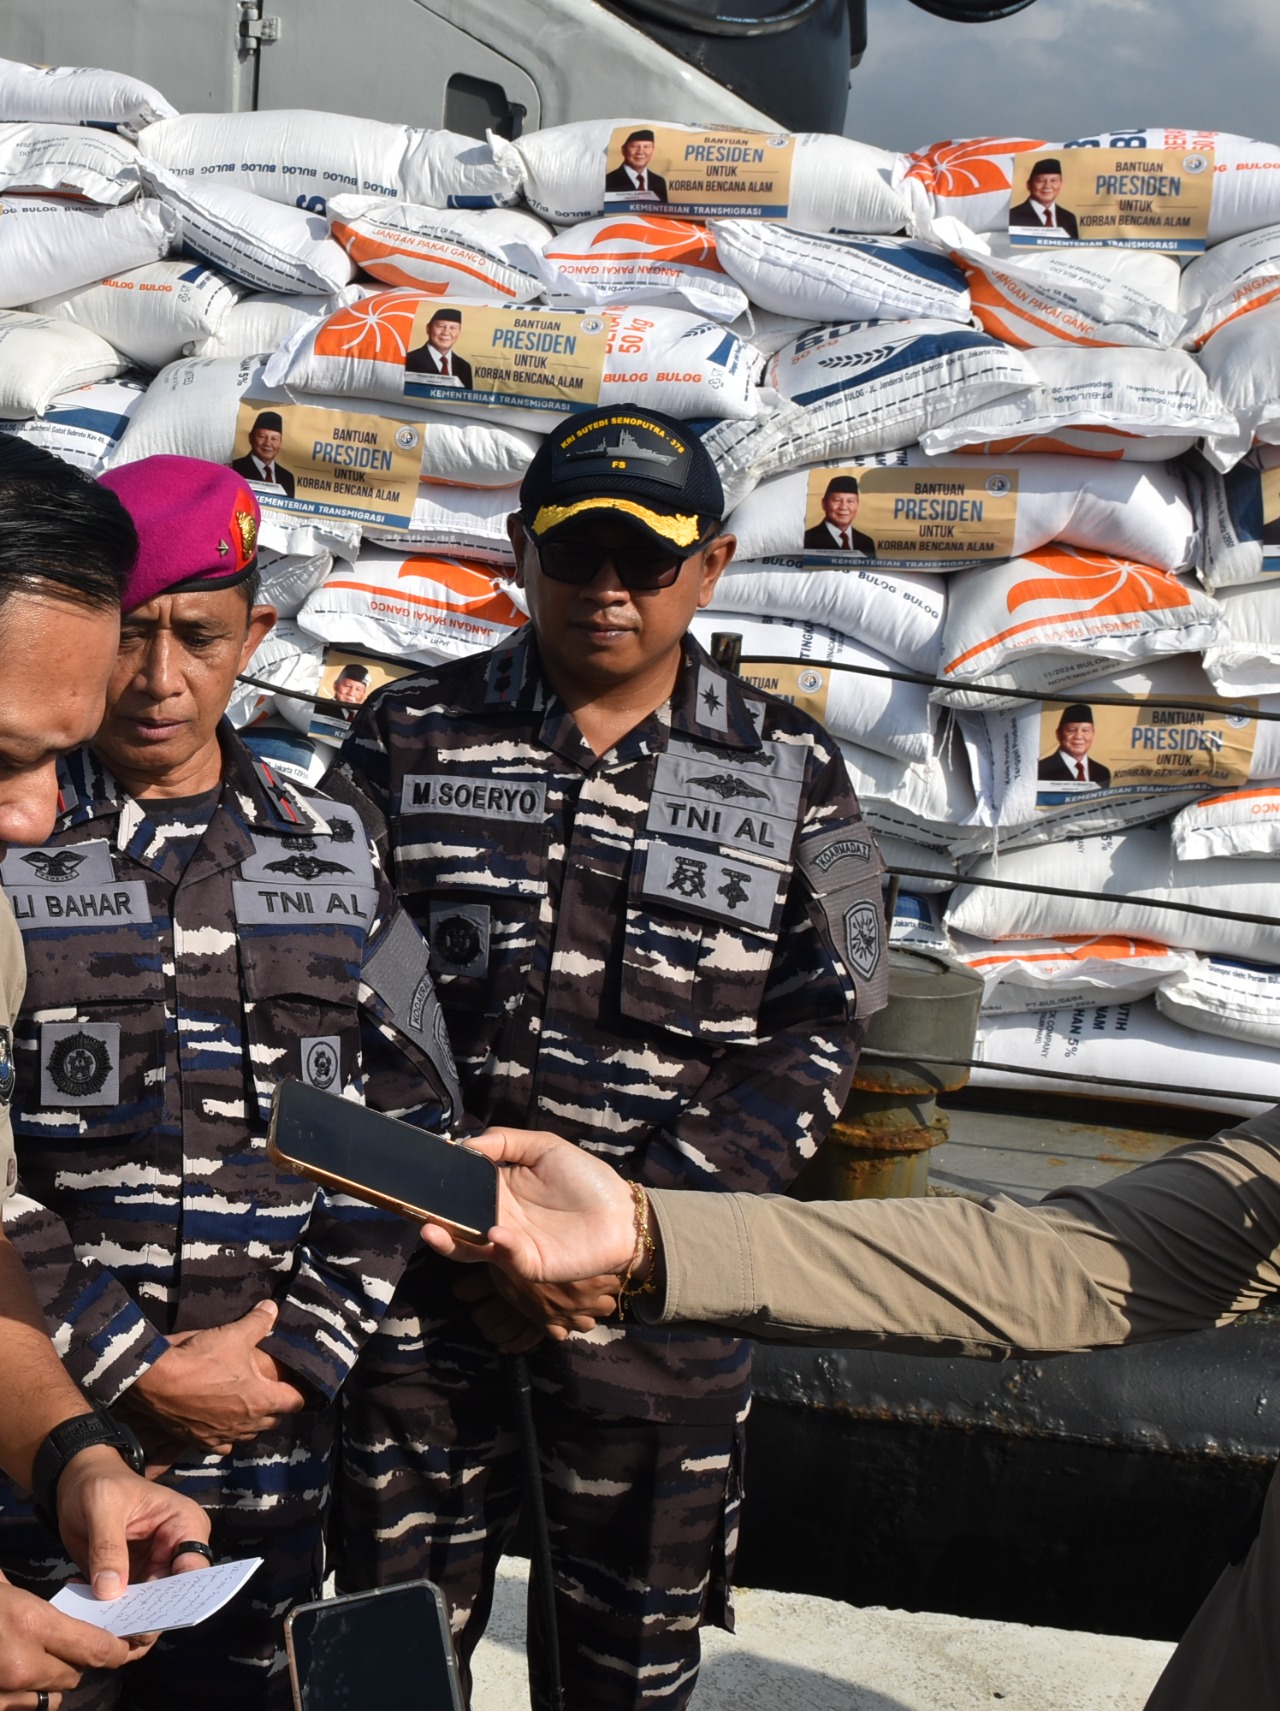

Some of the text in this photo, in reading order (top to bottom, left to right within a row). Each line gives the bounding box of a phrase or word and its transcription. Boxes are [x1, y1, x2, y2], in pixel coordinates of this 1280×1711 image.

[704, 136, 748, 146] BANTUAN
[684, 144, 764, 163] PRESIDEN
[706, 166, 737, 177] UNTUK
[1115, 162, 1163, 173] BANTUAN
[364, 183, 398, 197] BULOG
[668, 180, 773, 193] KORBAN BENCANA ALAM
[1096, 175, 1181, 196] PRESIDEN
[629, 204, 762, 216] KEMENTERIAN TRANSMIGRASI
[1119, 200, 1152, 212] UNTUK
[1079, 214, 1191, 227] KORBAN BENCANA ALAM
[373, 230, 487, 266] JANGAN PAKAI GANCO
[558, 265, 683, 278] JANGAN PAKAI GANCO
[102, 279, 134, 290] BULOG
[991, 270, 1060, 318] JANGAN PAKAI
[514, 318, 561, 332] BANTUAN
[492, 328, 577, 355] PRESIDEN
[514, 353, 547, 369] UNTUK
[475, 366, 584, 389] KORBAN BENCANA ALAM
[603, 371, 702, 383] BULOG BULOG
[879, 376, 904, 391] Jenderal
[430, 389, 570, 411] KEMENTERIAN TRANSMIGRASI
[67, 429, 86, 438] Subroto
[332, 428, 378, 445] BANTUAN
[560, 417, 685, 454] KRI SUTEDI SENOPUTRA 378
[312, 440, 392, 471] PRESIDEN
[334, 467, 366, 483] UNTUK
[297, 476, 331, 492] KORBAN
[333, 481, 372, 498] BENCANA
[374, 486, 400, 502] ALAM
[914, 482, 964, 496] BANTUAN
[318, 505, 385, 522] TRANSMIGRASI
[893, 498, 983, 522] PRESIDEN
[919, 524, 954, 537] UNTUK
[877, 540, 994, 552] KORBAN BENCANA ALAM
[858, 570, 939, 619] BULOG BULOG
[370, 601, 494, 637] JANGAN PAKAI GANCO
[1048, 668, 1099, 686] NOVEMBER
[1152, 712, 1204, 725] BANTUAN
[1131, 727, 1223, 750] PRESIDEN
[1156, 753, 1192, 766] UNTUK
[274, 763, 293, 773] Jakarta
[1201, 769, 1229, 780] ALAM
[412, 782, 537, 814] M.SOERYO
[1064, 786, 1132, 803] KEMENTERIAN
[667, 803, 775, 848] TNI AL
[820, 842, 858, 867] KOARMADA
[15, 893, 133, 919] LI BAHAR
[258, 891, 368, 918] TNI AL
[893, 919, 917, 930] Jakarta
[1064, 1037, 1079, 1057] 5%
